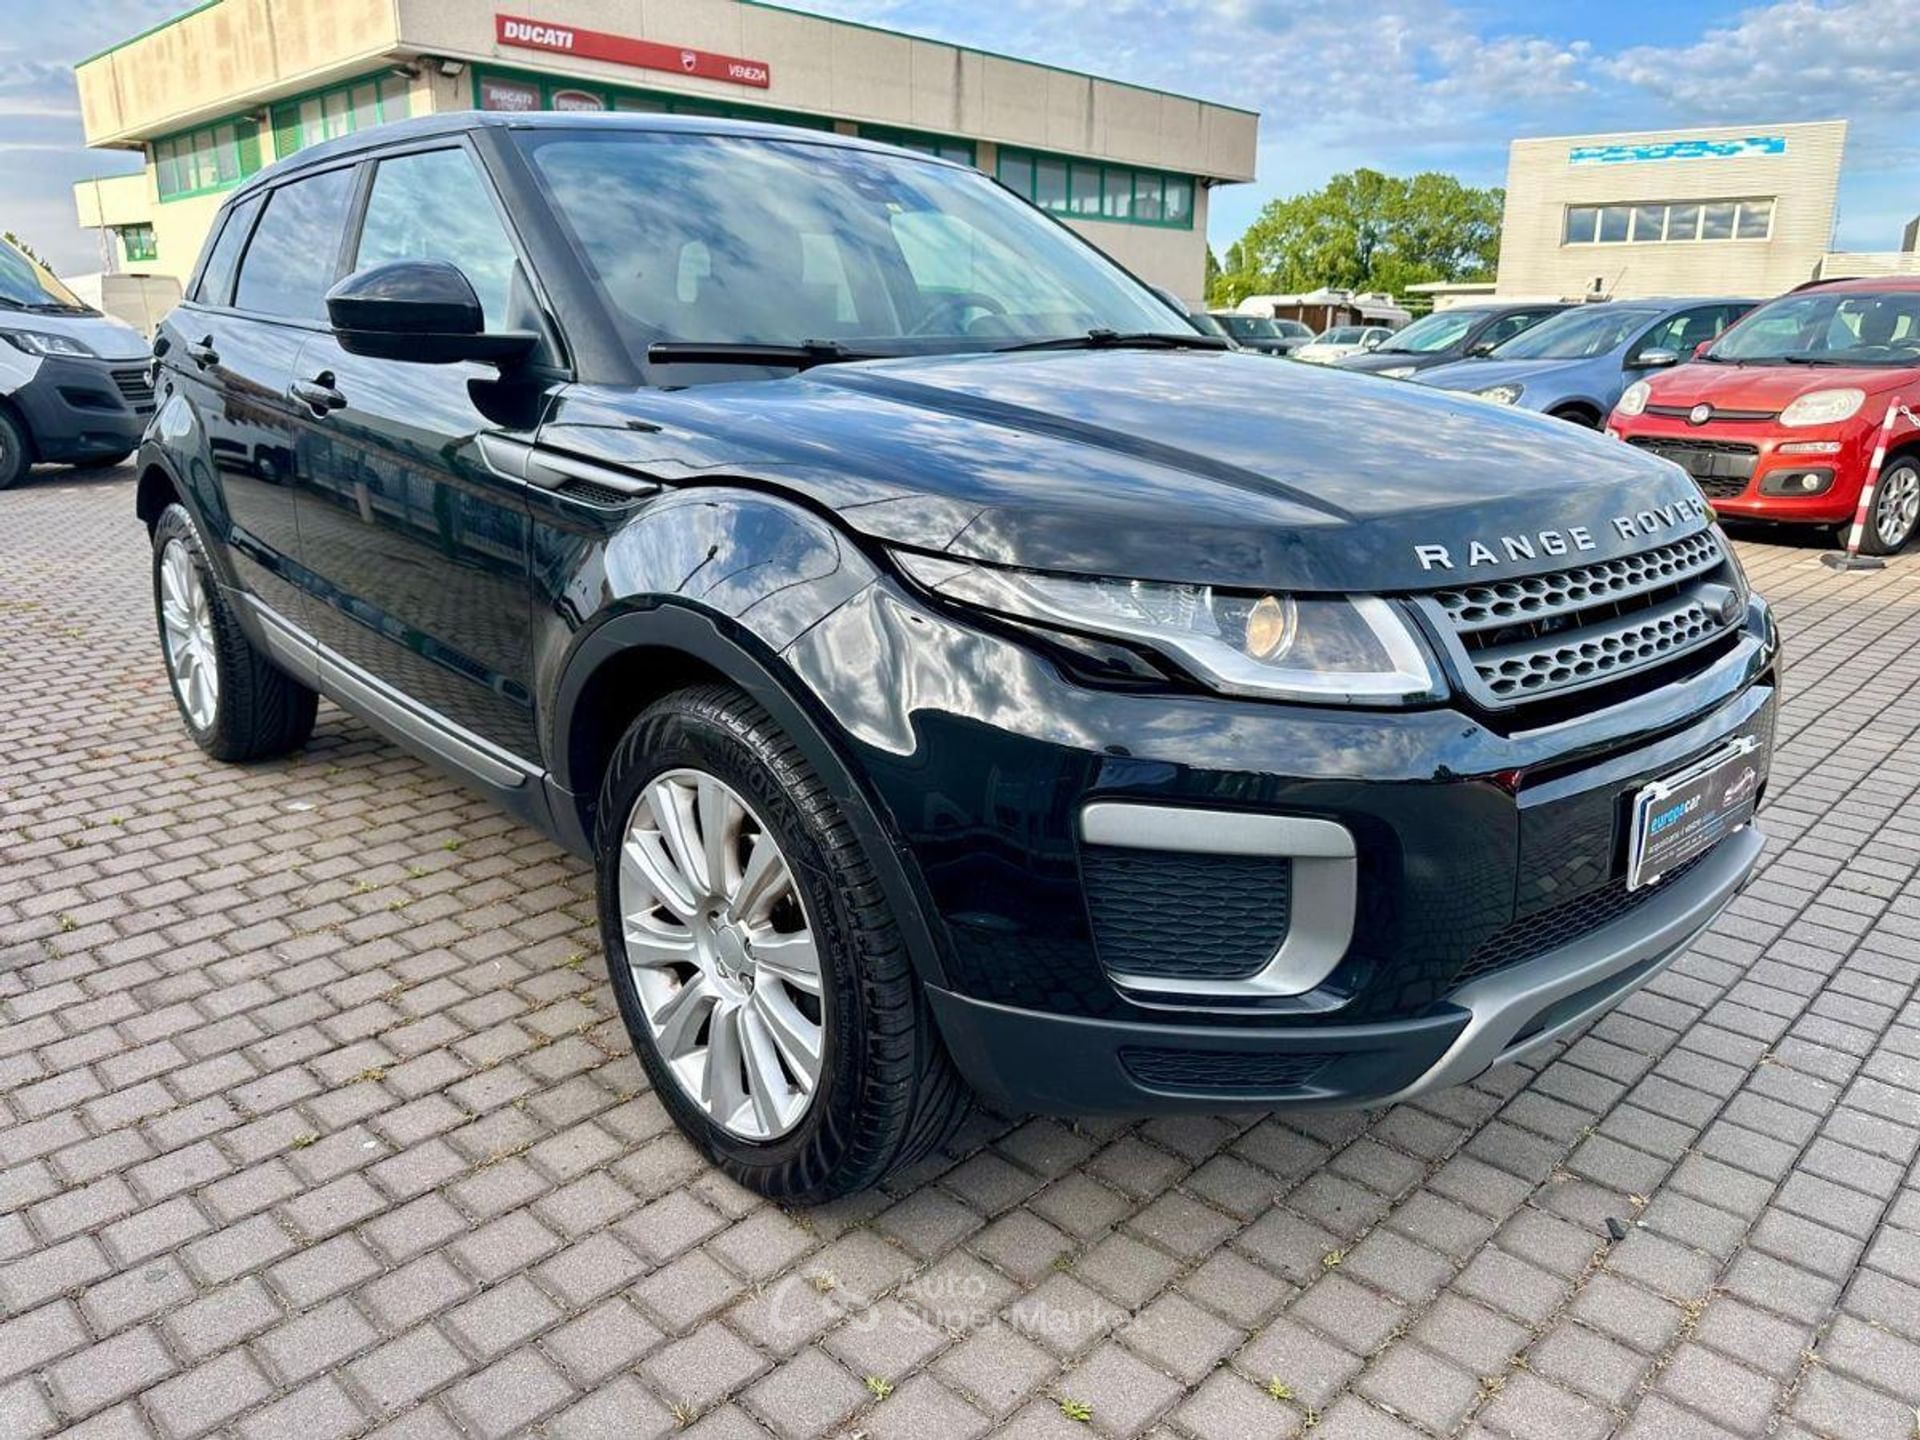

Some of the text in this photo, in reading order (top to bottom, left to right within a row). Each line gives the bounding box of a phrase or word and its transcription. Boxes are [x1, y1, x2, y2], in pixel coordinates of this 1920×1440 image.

[504, 21, 767, 82] DUCATI VENEZIA
[1414, 498, 1704, 570] RANGE ROVER
